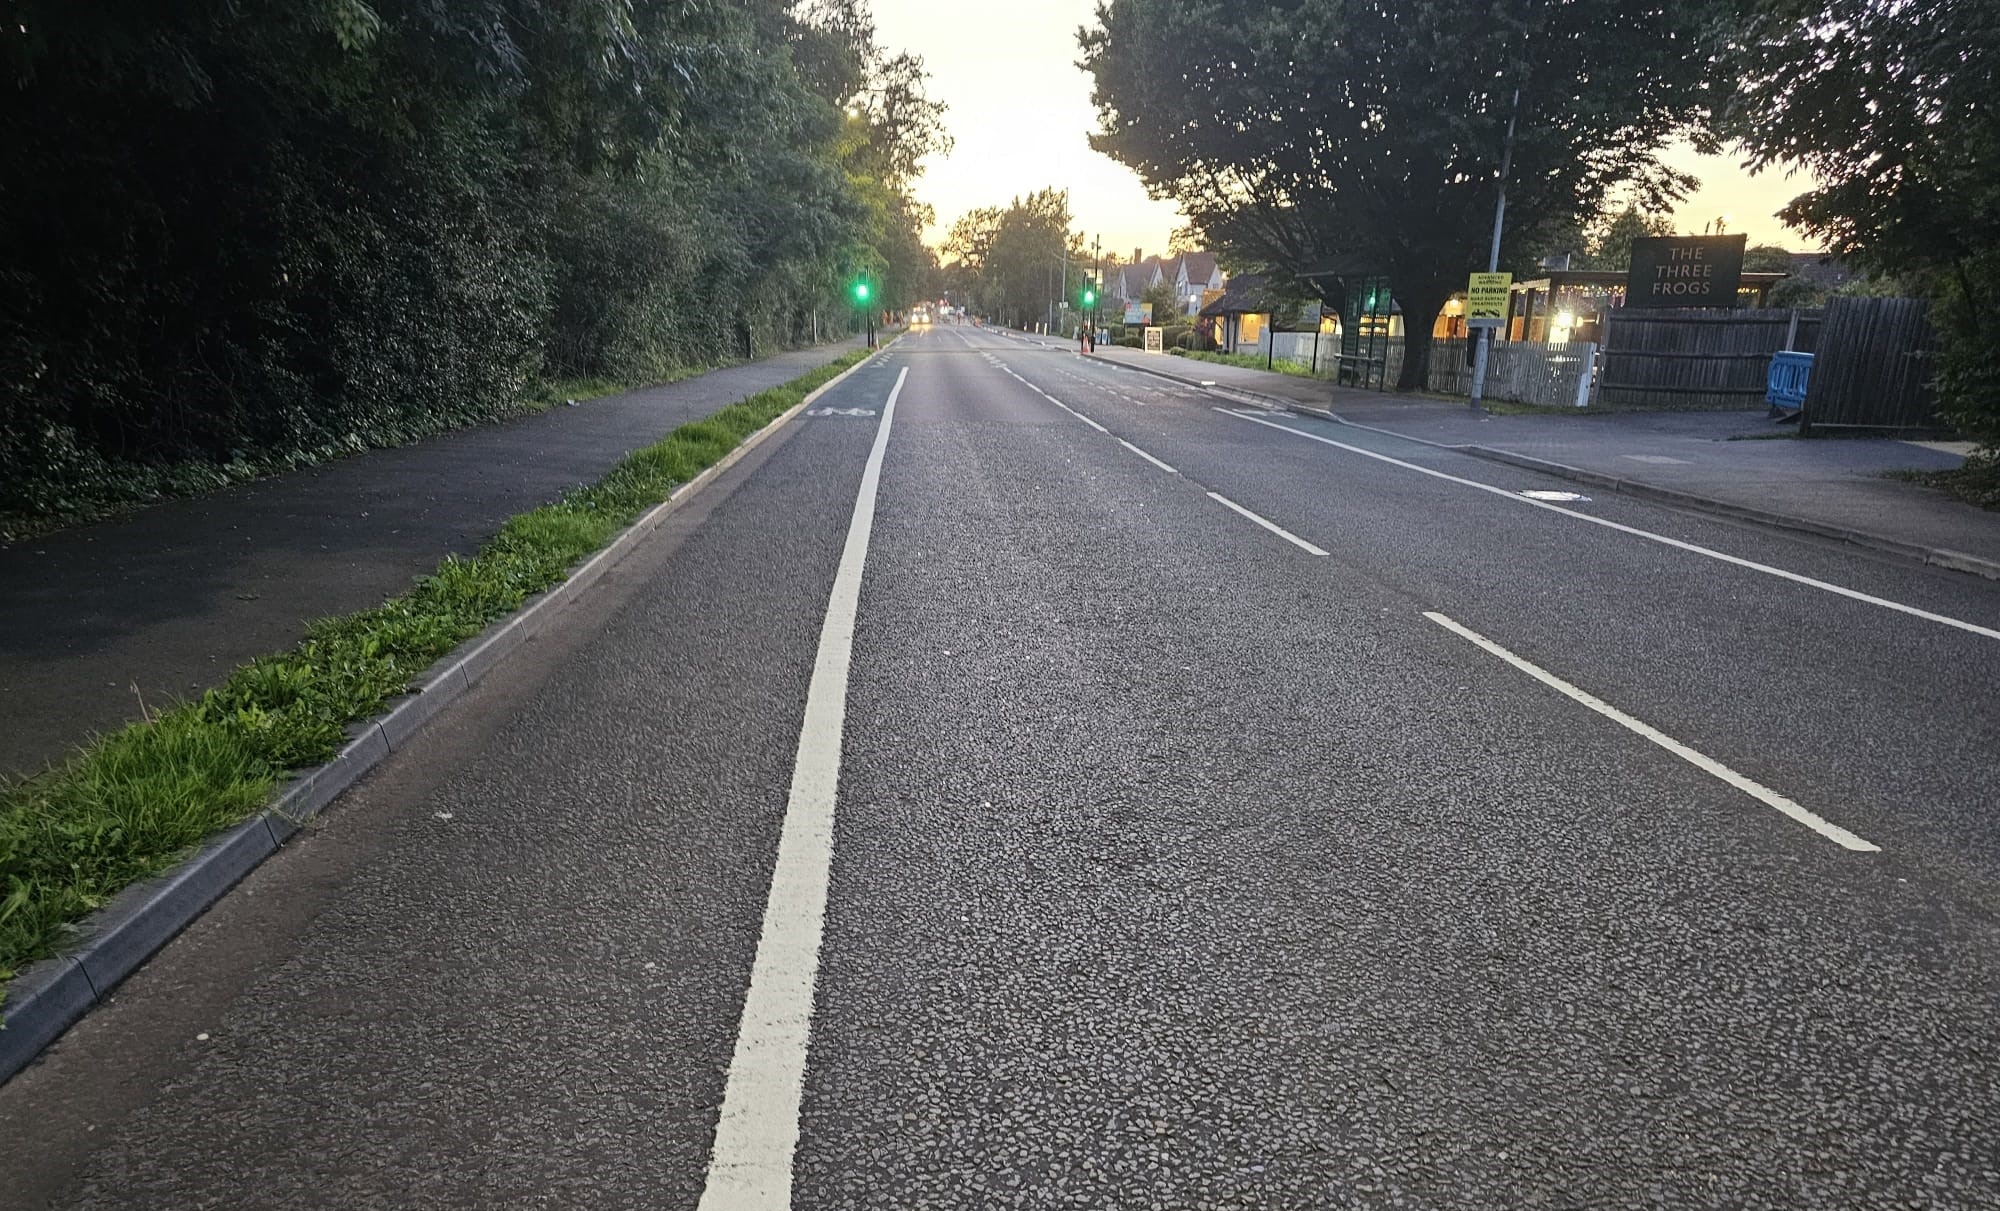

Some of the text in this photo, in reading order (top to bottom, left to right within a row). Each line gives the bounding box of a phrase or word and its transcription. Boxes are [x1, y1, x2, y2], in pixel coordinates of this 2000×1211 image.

[1669, 246, 1705, 261] THE
[1655, 264, 1713, 279] THREE
[1652, 281, 1711, 296] FROGS
